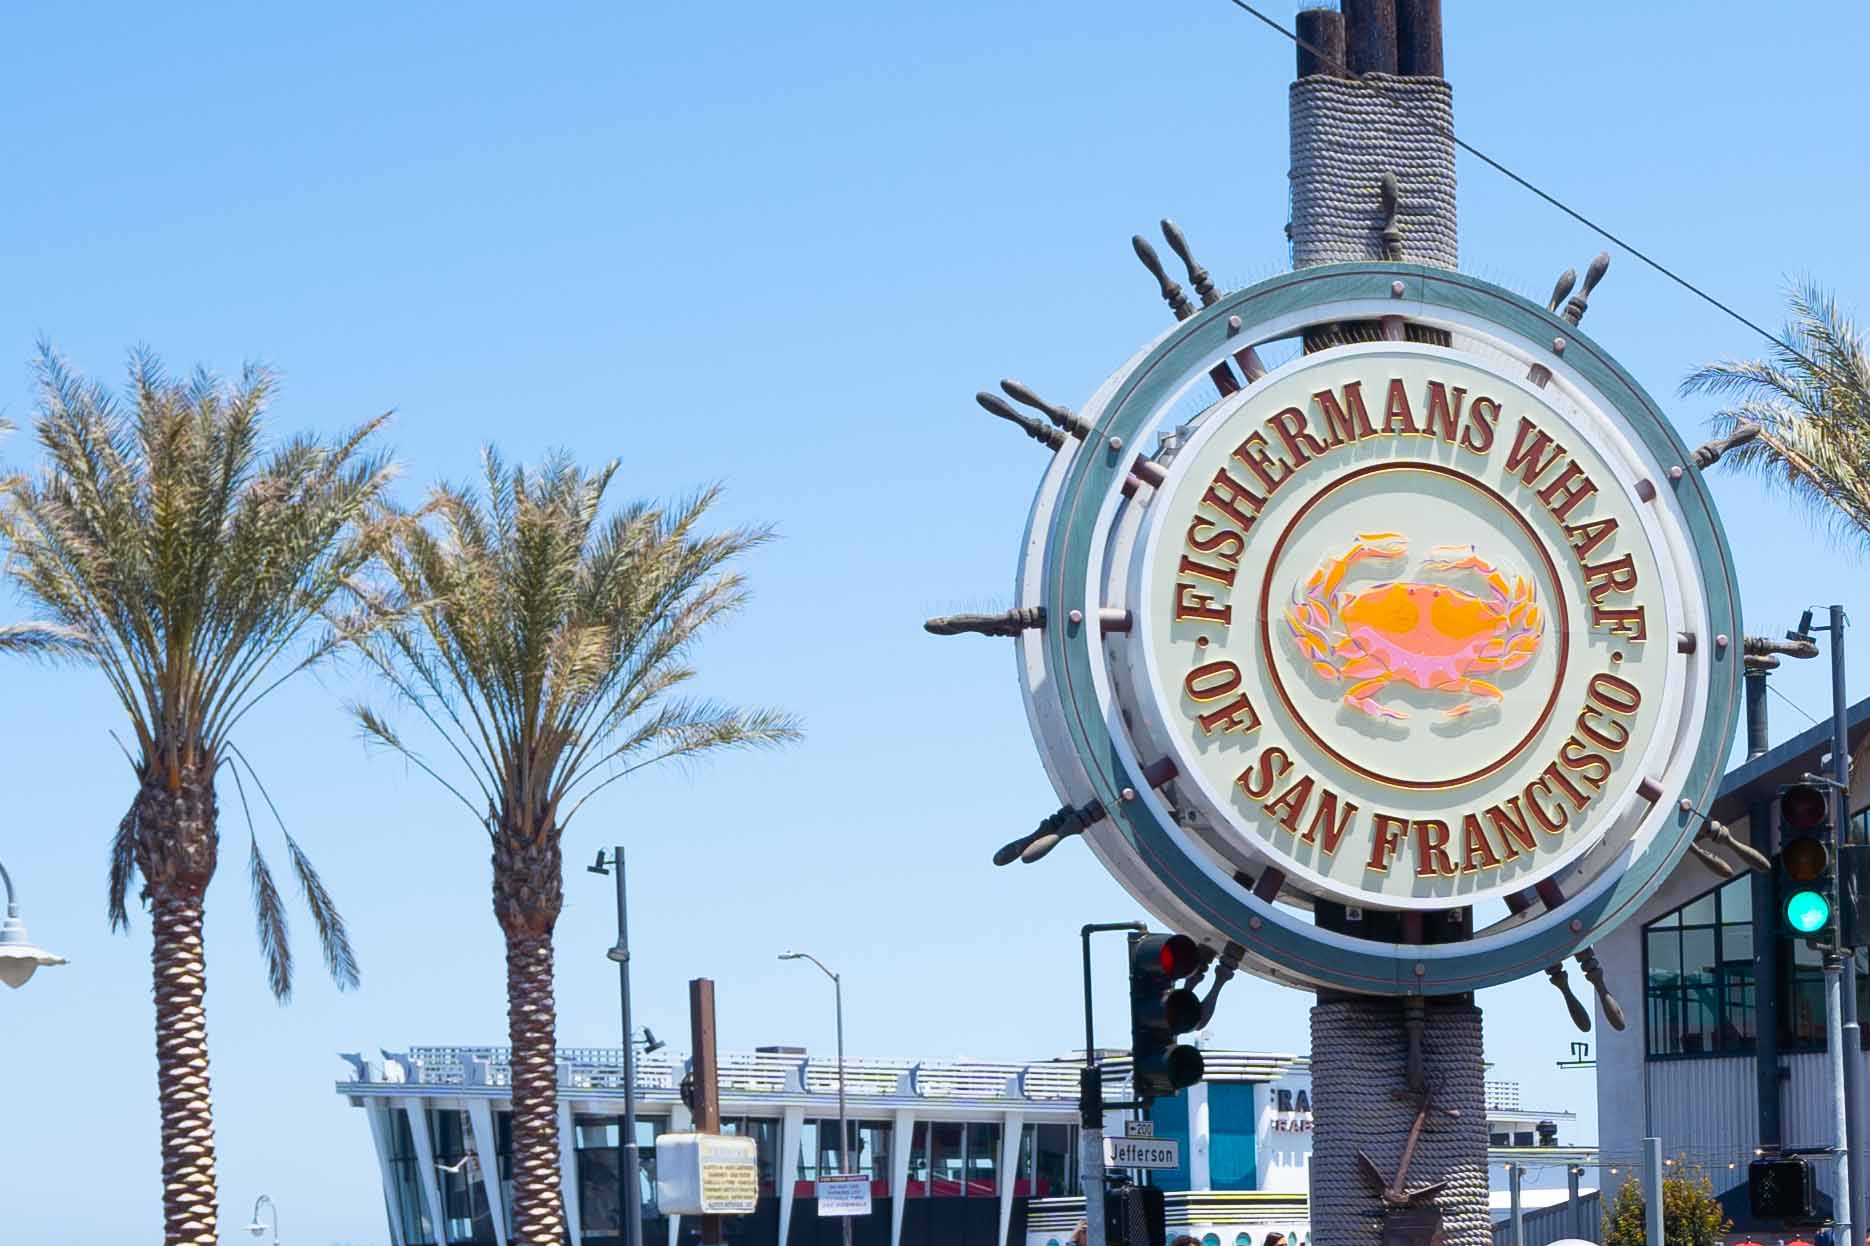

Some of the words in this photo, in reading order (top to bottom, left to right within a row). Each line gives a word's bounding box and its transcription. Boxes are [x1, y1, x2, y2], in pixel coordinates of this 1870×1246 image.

[1175, 377, 1504, 628] FISHERMANS
[1504, 416, 1648, 646] WHARF
[1184, 659, 1263, 737] OF
[1236, 745, 1358, 857] SAN
[1366, 674, 1643, 879] FRANCISCO
[1110, 1143, 1173, 1162] Jefferson
